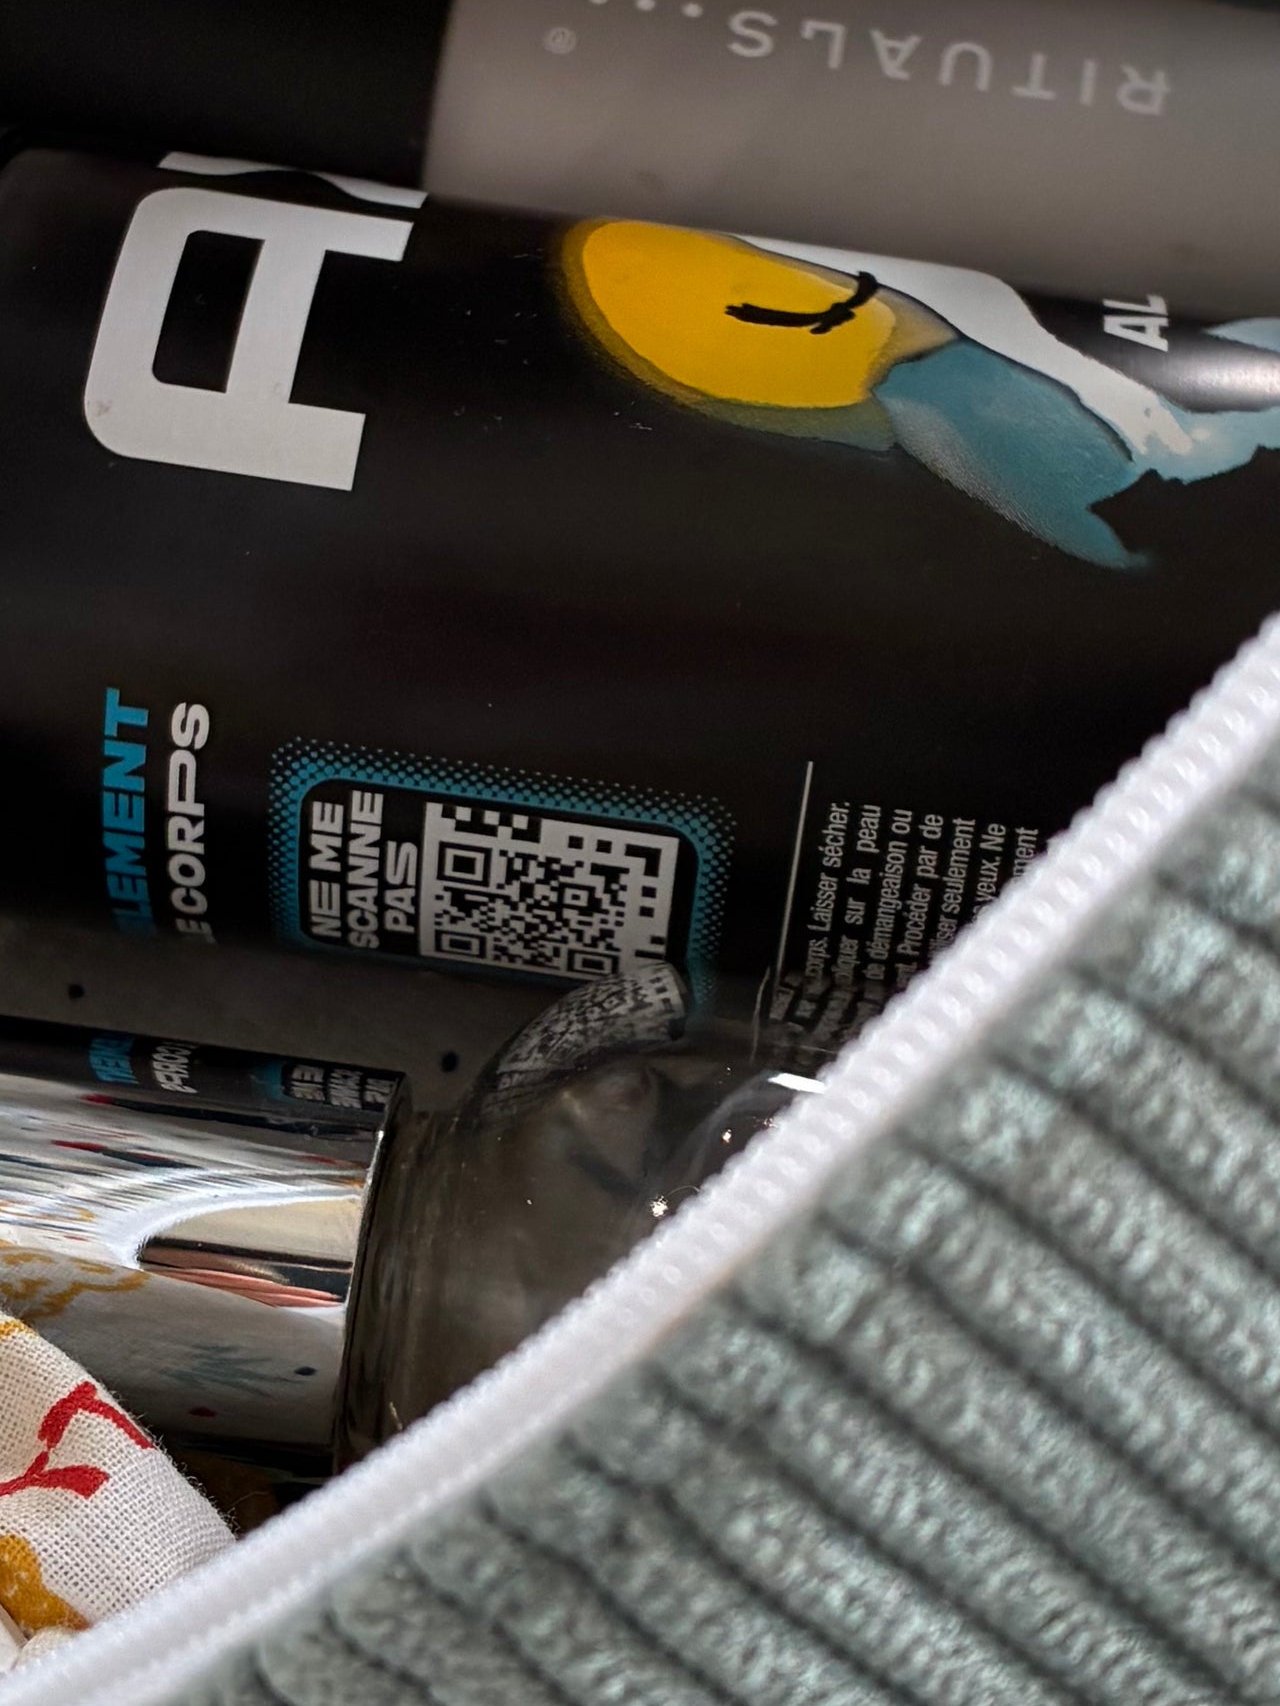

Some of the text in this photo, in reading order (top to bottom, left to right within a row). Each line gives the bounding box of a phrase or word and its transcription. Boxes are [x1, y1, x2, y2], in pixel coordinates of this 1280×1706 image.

[1103, 294, 1170, 352] AL
[102, 687, 156, 937] LEMENT
[166, 702, 210, 917] CORPS
[820, 801, 850, 867] sécher.
[857, 804, 882, 854] peau
[922, 813, 943, 840] de
[979, 823, 1006, 851] Ne
[310, 801, 345, 938] NE ME
[346, 791, 384, 949] SCANNE
[382, 841, 418, 934] PAS
[846, 867, 872, 886] la
[868, 841, 908, 959] démangeaison
[891, 809, 912, 834] ou
[918, 845, 939, 878] par
[940, 817, 975, 910] seulement
[808, 872, 839, 932] Laisser
[844, 898, 864, 926] sur
[897, 883, 931, 956] Procéder
